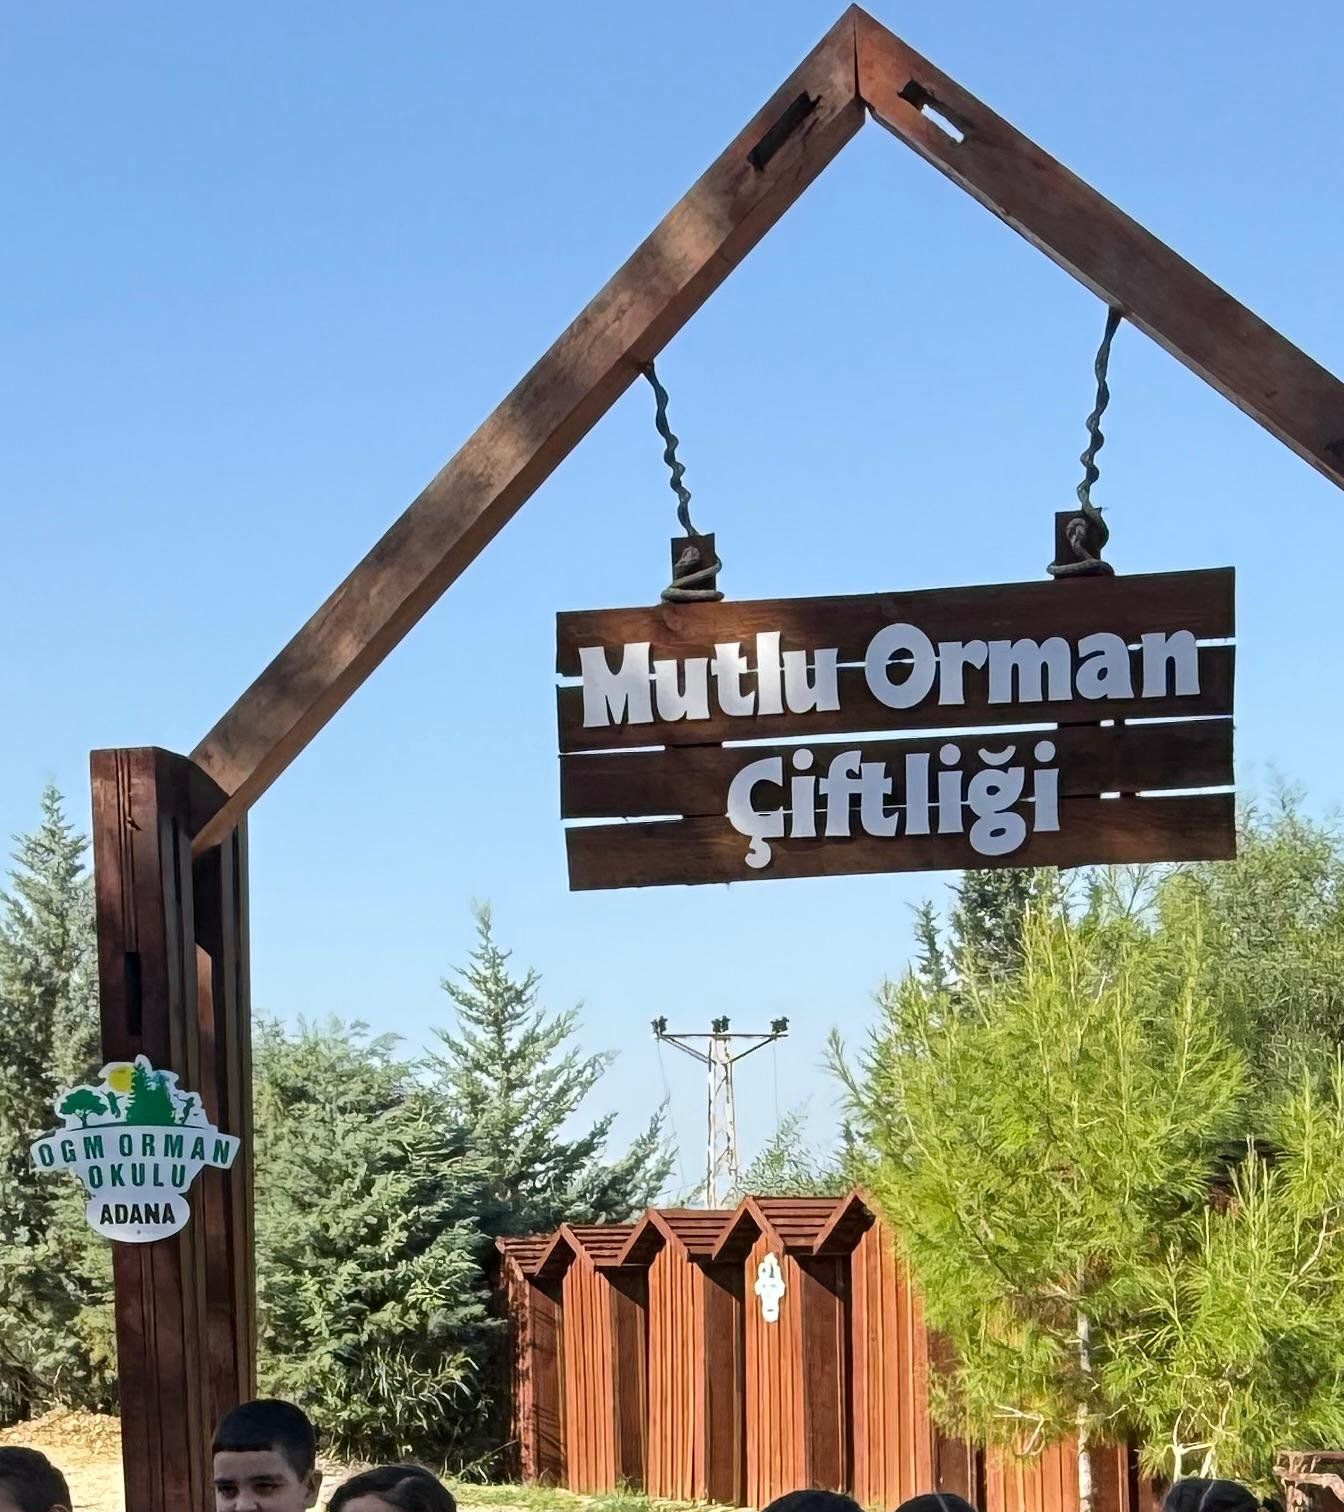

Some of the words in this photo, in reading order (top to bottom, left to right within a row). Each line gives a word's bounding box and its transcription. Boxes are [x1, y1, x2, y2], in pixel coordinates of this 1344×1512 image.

[578, 631, 841, 729] Mutlu
[864, 622, 1201, 710] Orman
[727, 740, 1061, 869] Çiftliği
[38, 1134, 105, 1167] OGM
[119, 1133, 230, 1165] ORMAN
[87, 1163, 187, 1189] OKULU
[99, 1203, 177, 1226] ADANA
